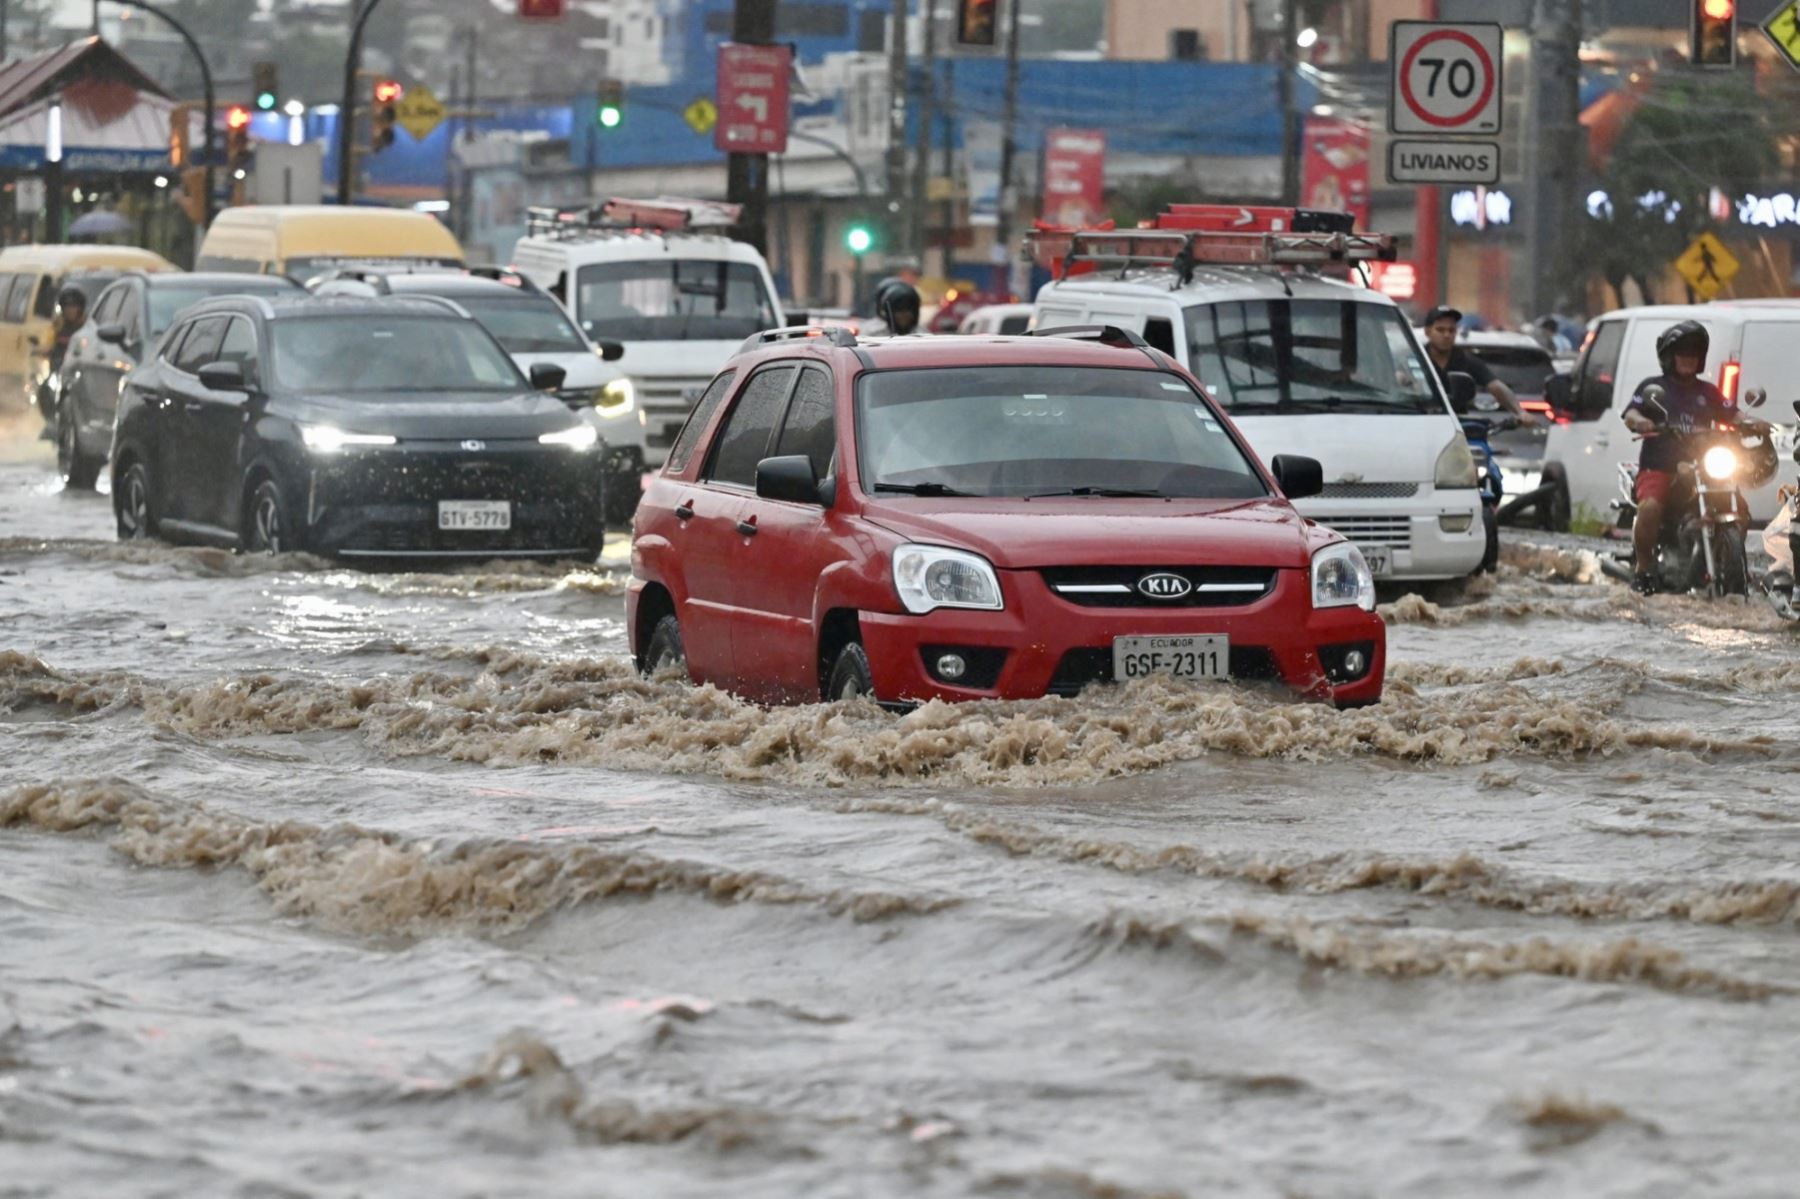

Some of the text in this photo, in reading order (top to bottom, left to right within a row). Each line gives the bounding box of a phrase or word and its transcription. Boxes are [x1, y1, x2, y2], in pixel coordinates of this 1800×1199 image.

[1418, 58, 1475, 98] 70
[1400, 153, 1489, 172] LIVIANOS
[441, 511, 508, 526] GTV-5778
[1148, 579, 1183, 592] KIA
[1150, 639, 1194, 648] ECUADOR
[1125, 652, 1218, 677] GSF-2311
